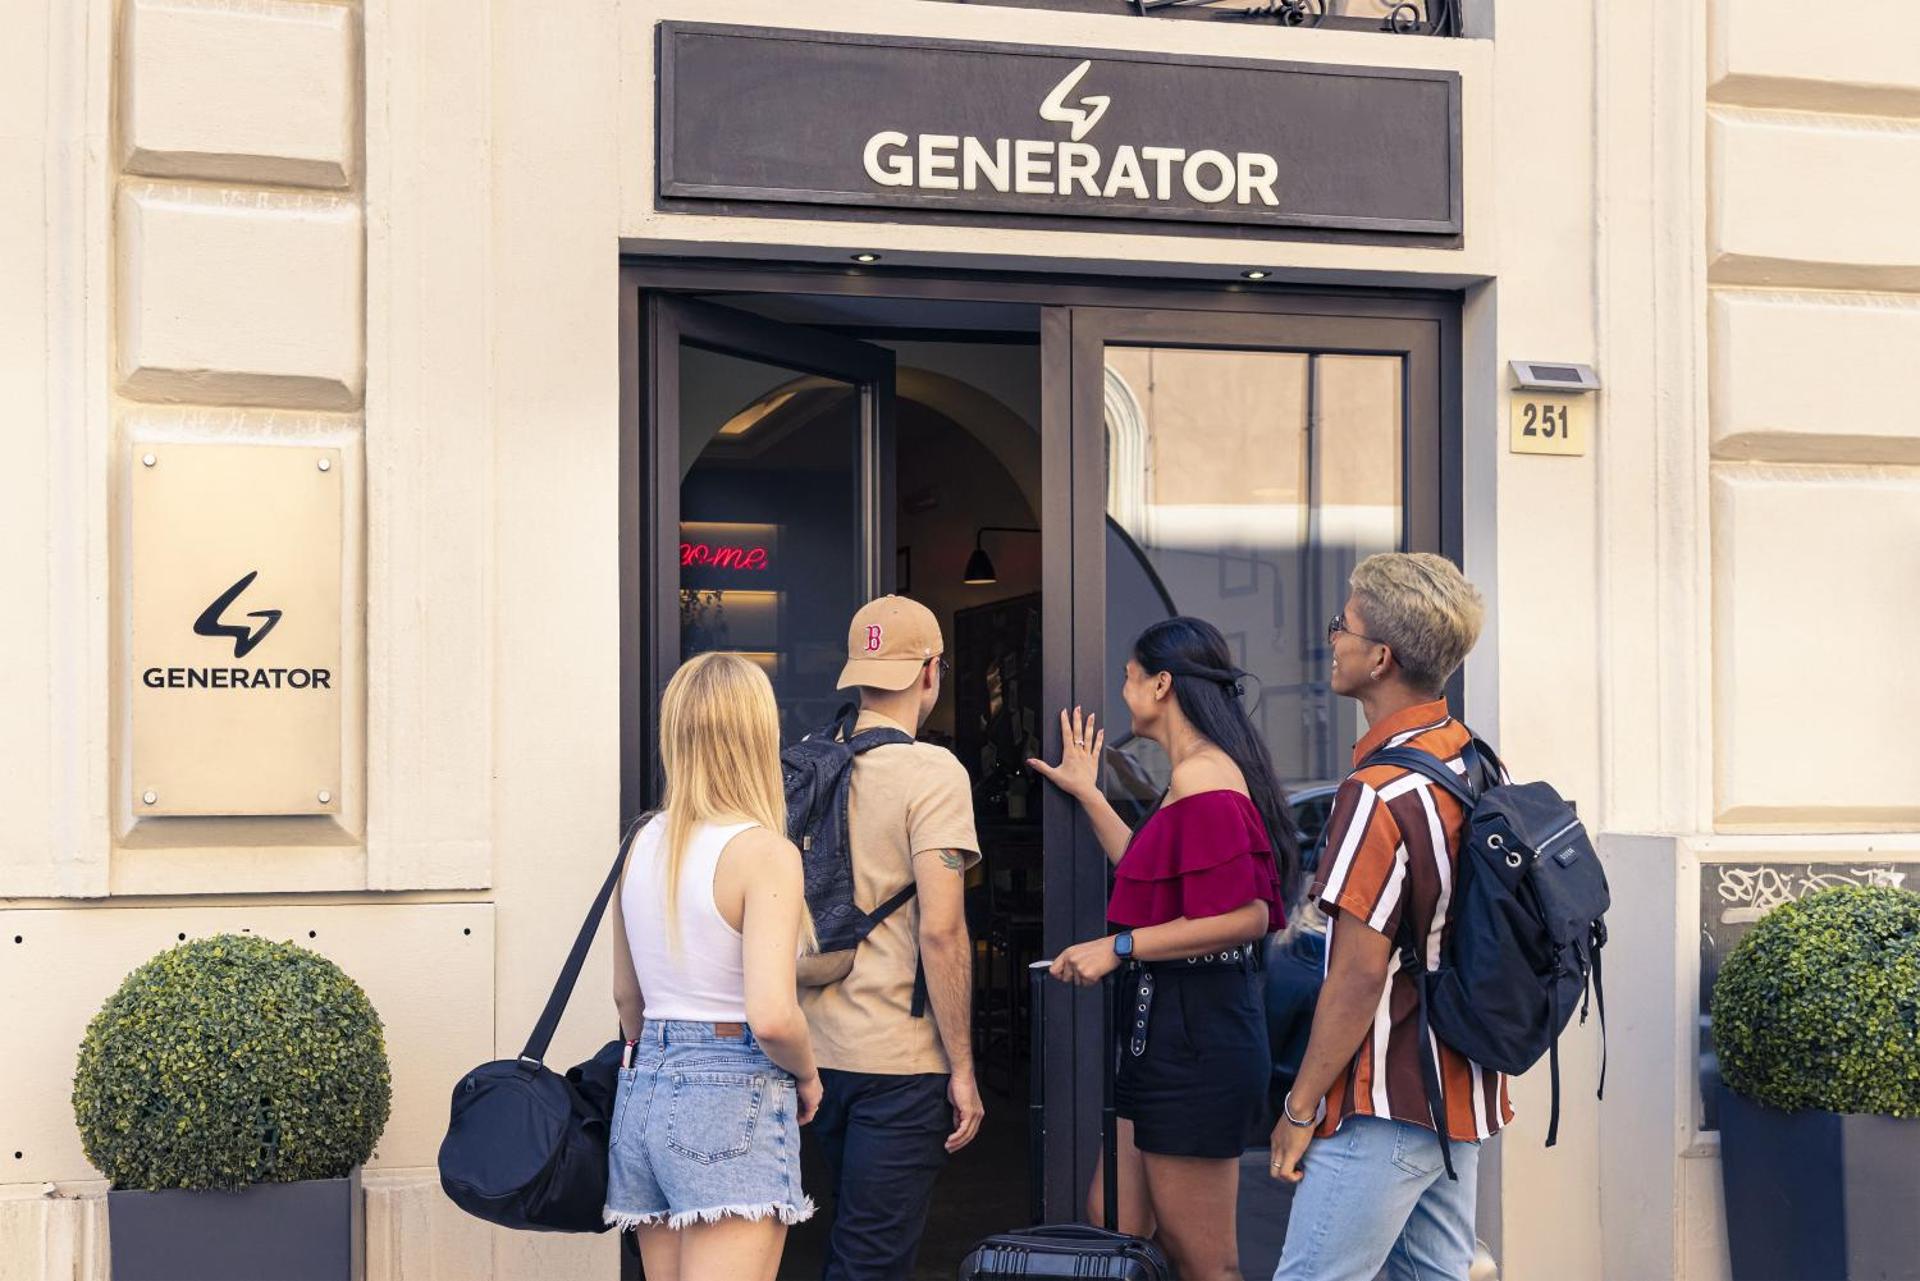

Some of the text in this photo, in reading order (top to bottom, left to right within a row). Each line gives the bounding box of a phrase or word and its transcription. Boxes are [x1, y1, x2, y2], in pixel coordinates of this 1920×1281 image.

[863, 130, 1280, 207] GENERATOR
[1523, 403, 1568, 439] 251
[865, 624, 882, 652] B
[143, 667, 331, 689] GENERATOR
